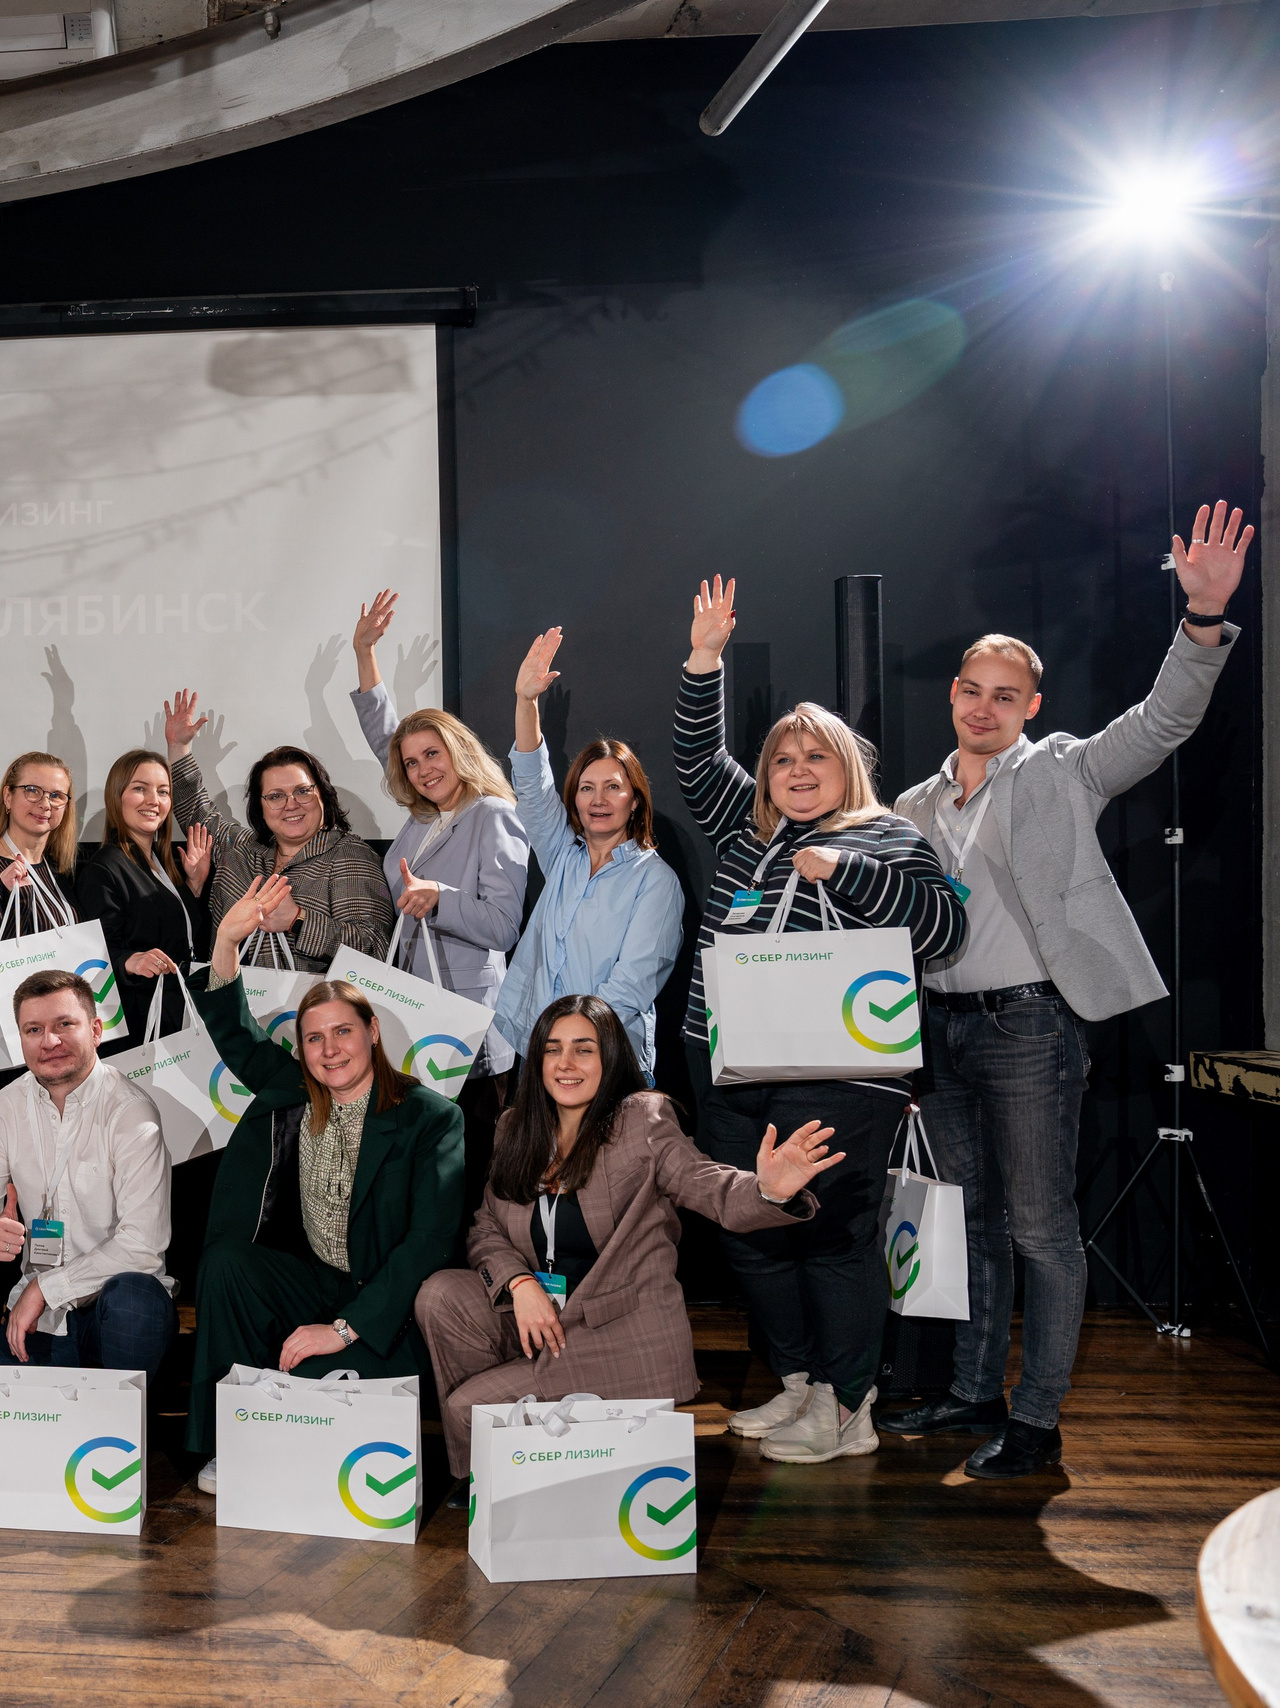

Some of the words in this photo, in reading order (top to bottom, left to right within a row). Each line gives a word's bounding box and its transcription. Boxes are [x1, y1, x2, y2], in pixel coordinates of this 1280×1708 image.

[5, 958, 25, 969] СБЕР
[26, 951, 56, 964] ЛИЗИНГ
[752, 953, 782, 962] СБЕР
[785, 952, 833, 961] ЛИЗИНГ
[246, 988, 267, 996] ЗИНГ
[359, 977, 384, 992] СБЕР
[385, 989, 424, 1010] ЛИЗИНГ
[127, 1065, 152, 1080] СБЕР
[153, 1050, 191, 1070] ЛИЗИНГ
[13, 1411, 62, 1422] ЛИЗИНГ
[252, 1411, 282, 1421] СБЕР
[285, 1414, 335, 1426] ЛИЗИНГ
[529, 1451, 562, 1461] СБЕР
[564, 1448, 615, 1460] ЛИЗИНГ
